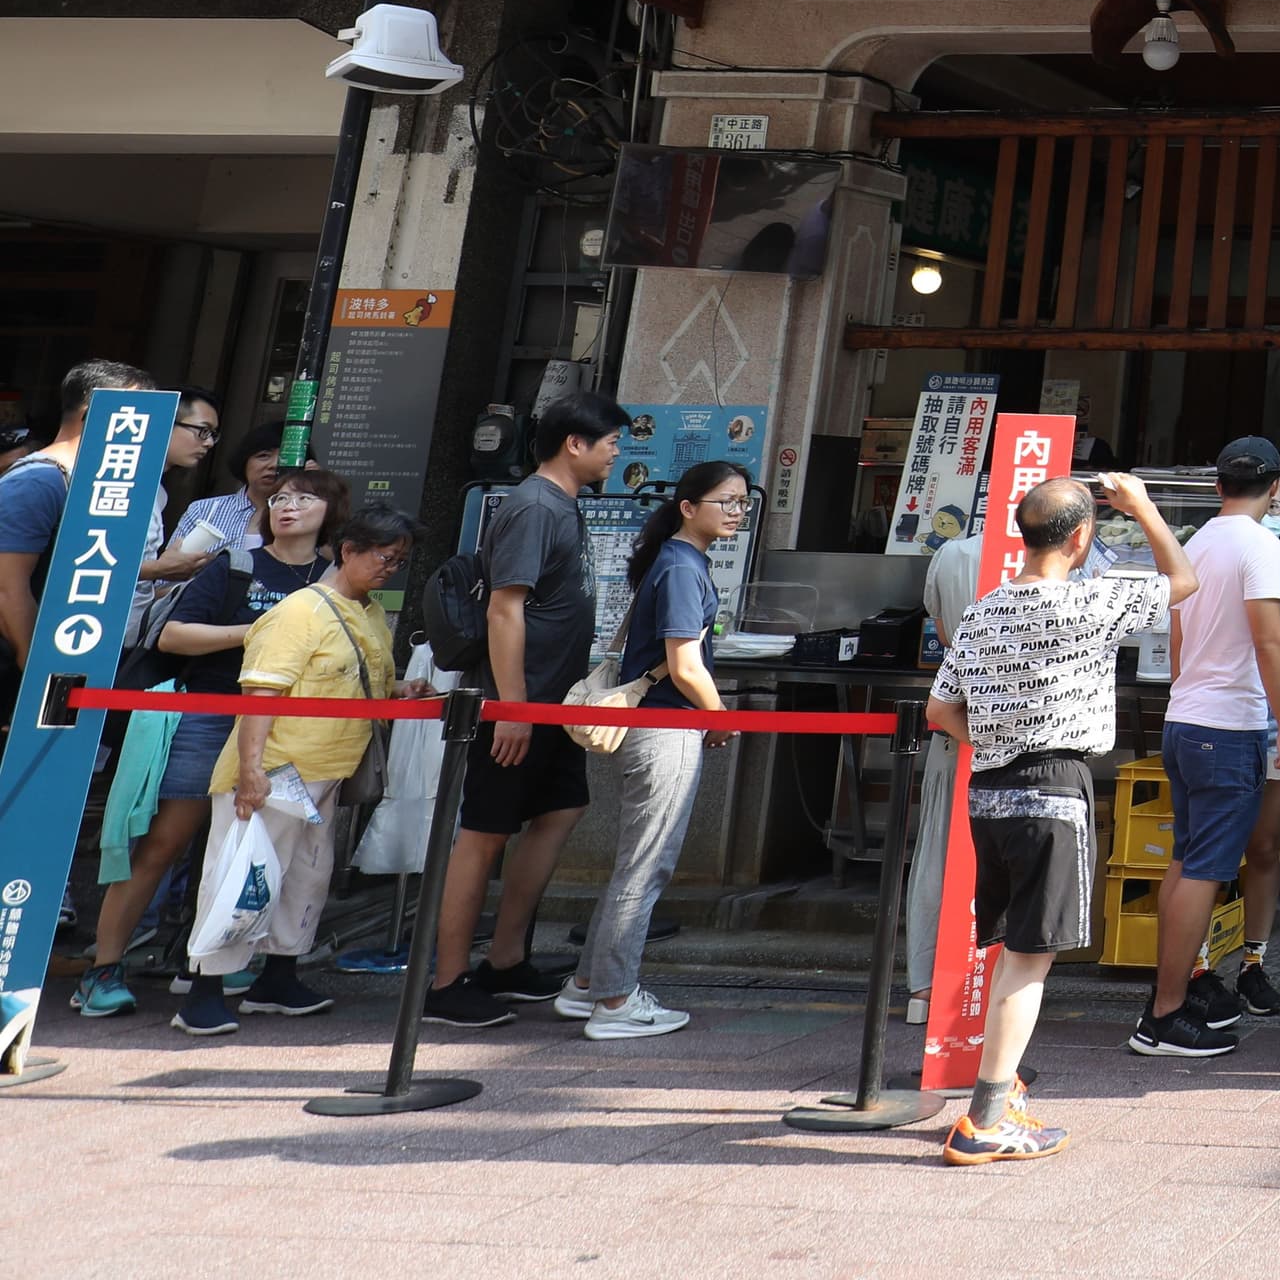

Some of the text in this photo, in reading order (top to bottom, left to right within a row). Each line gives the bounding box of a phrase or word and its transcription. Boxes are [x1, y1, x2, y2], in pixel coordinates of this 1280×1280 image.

[727, 119, 762, 130] 中正路
[724, 134, 752, 151] 361
[348, 297, 390, 311] 波特多
[938, 395, 967, 456] 請自行
[905, 395, 944, 496] 抽取號碼牌
[956, 397, 988, 476] 內用客滿
[67, 406, 150, 604] 內用區 入口
[1008, 587, 1040, 598] PUMA
[983, 606, 1017, 618] PUMA
[959, 614, 1088, 641] PUMA PUMA PUMA
[979, 644, 1008, 657] PUMA
[1020, 638, 1061, 652] PUMA
[996, 661, 1031, 674] PUMA
[1045, 650, 1090, 667] PUMA
[970, 684, 1009, 696] PUMA
[1018, 675, 1059, 691] PUMA
[991, 701, 1029, 714] PUMA
[1014, 713, 1054, 728] PUMA
